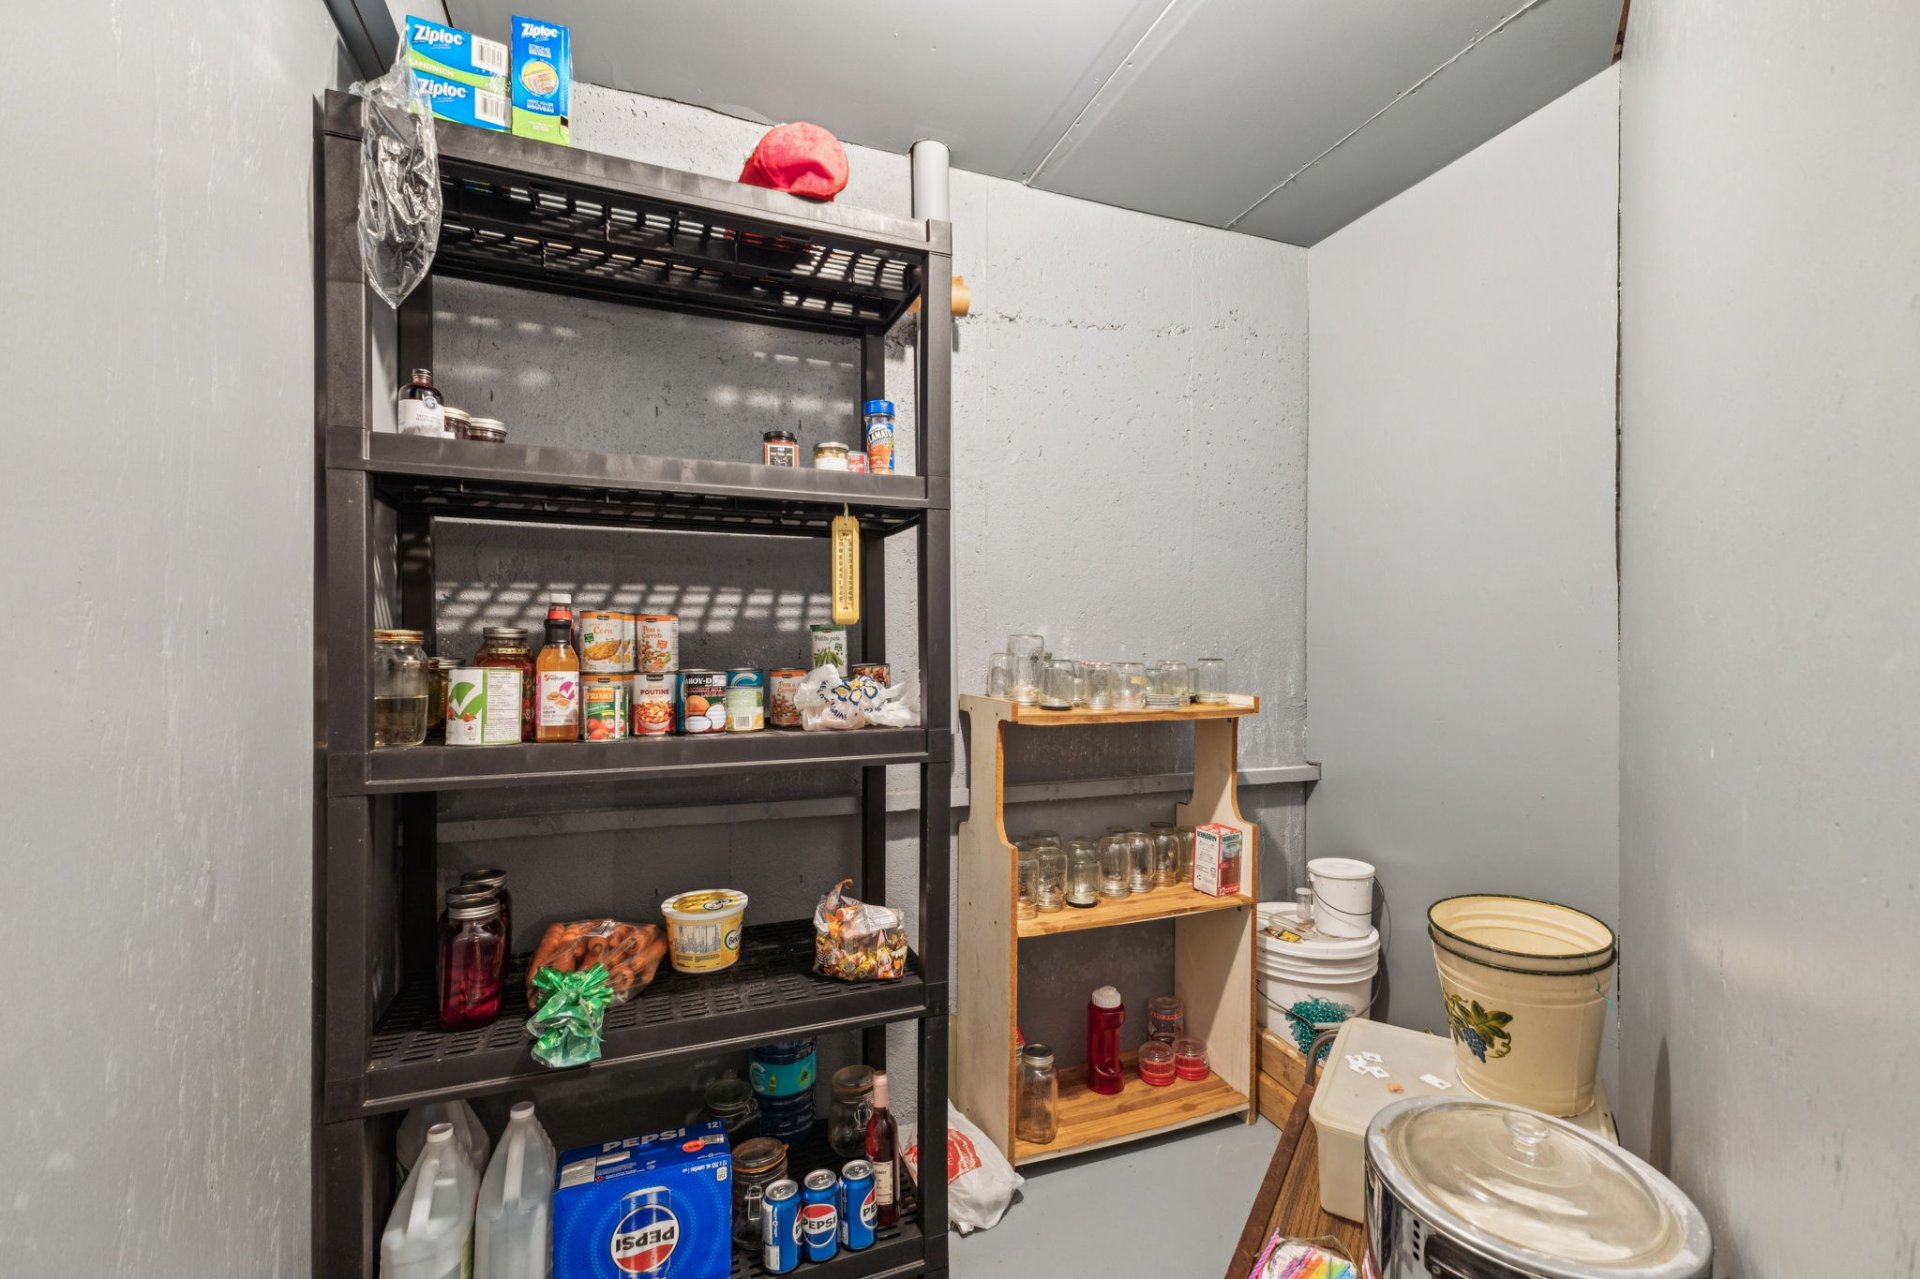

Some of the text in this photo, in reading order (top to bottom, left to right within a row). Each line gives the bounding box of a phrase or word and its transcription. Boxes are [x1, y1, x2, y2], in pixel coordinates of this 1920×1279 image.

[413, 24, 463, 46] Ziploc
[521, 22, 558, 38] Ziploc
[417, 77, 466, 98] Ziploc
[602, 1128, 686, 1153] PEPSI
[706, 1121, 720, 1129] 12
[802, 1216, 836, 1230] PEPSI
[615, 1226, 675, 1253] PEPSI
